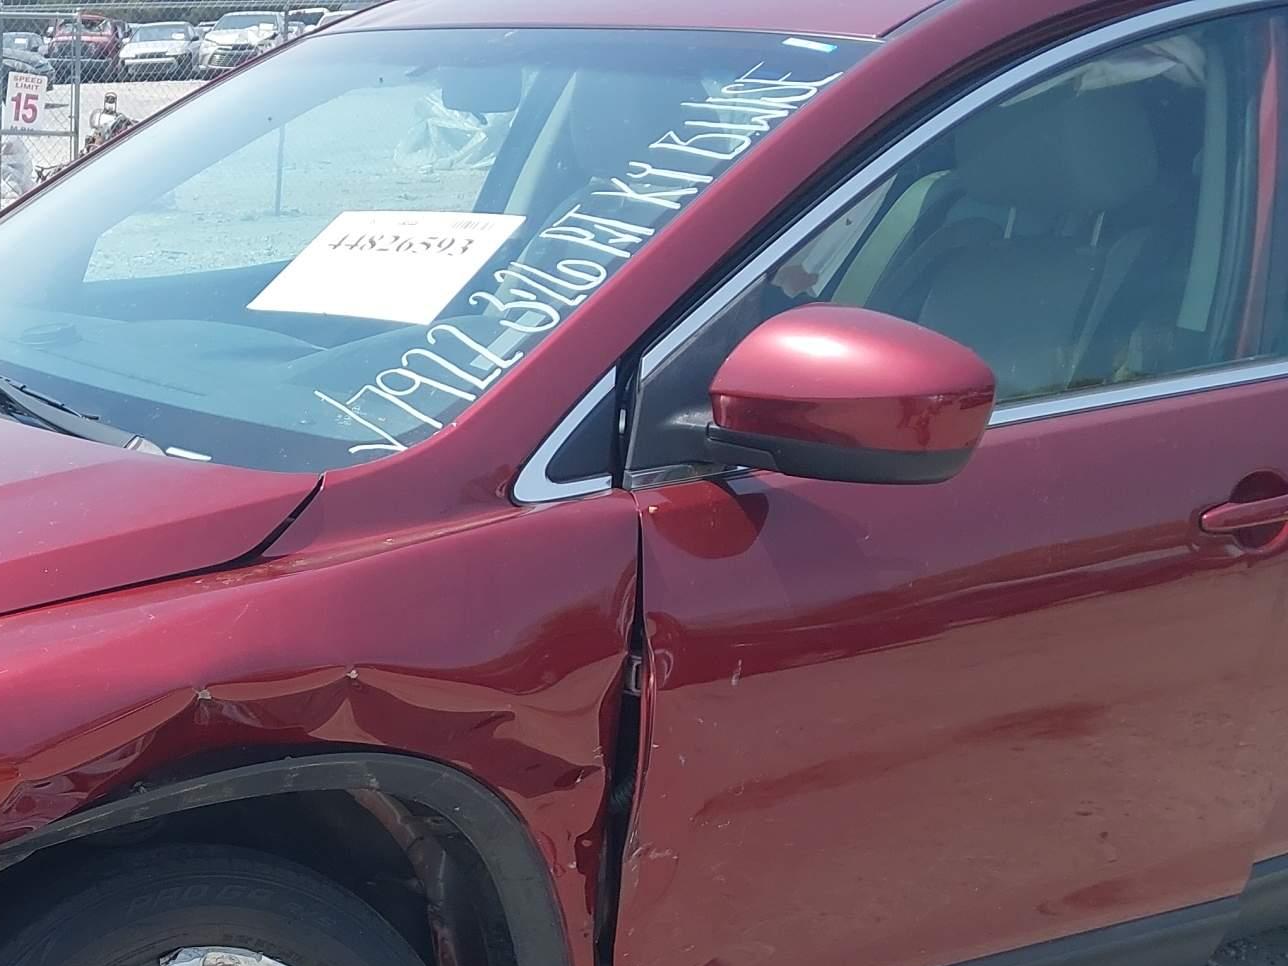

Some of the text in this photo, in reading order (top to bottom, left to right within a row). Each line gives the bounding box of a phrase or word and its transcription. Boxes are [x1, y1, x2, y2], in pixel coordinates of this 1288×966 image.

[13, 75, 43, 84] SPEED
[15, 82, 40, 90] LIMIT
[11, 92, 39, 124] 15
[328, 232, 475, 256] 44826593
